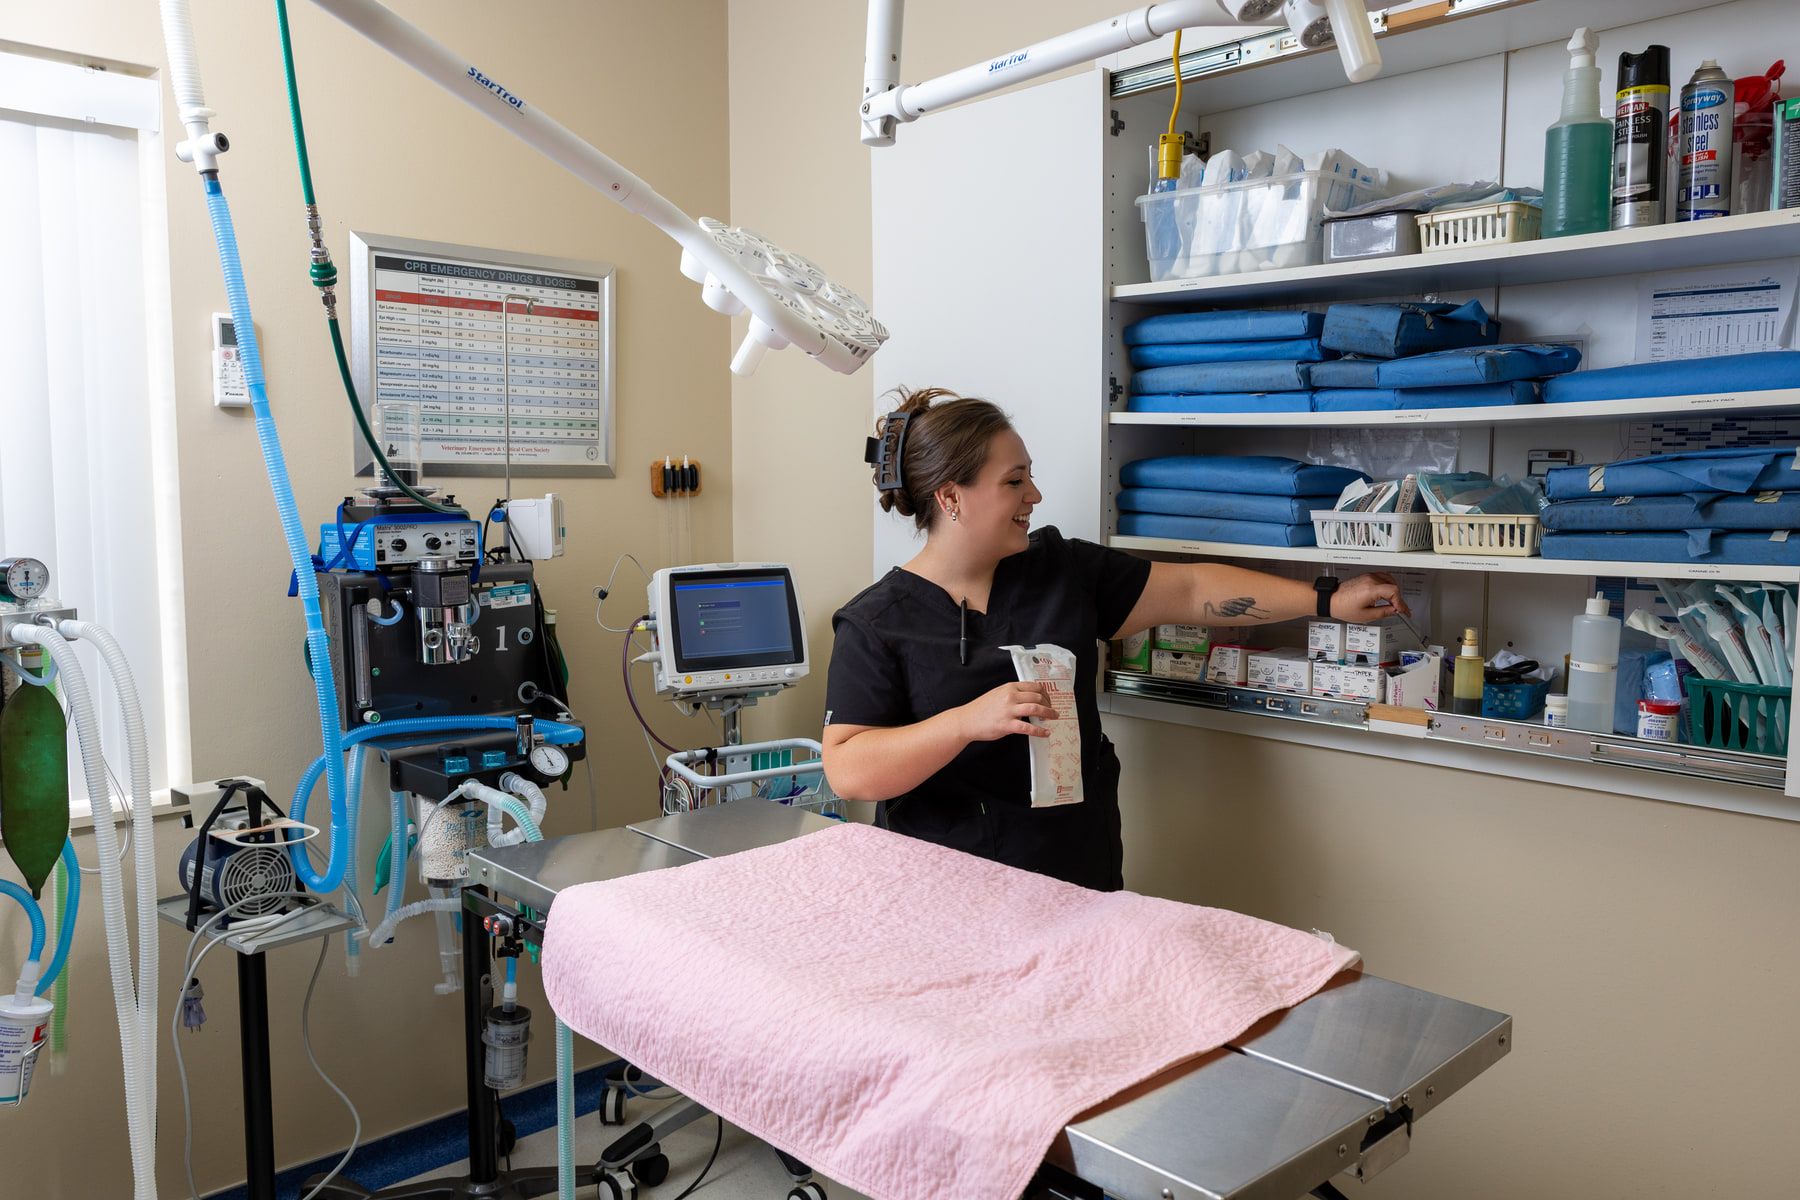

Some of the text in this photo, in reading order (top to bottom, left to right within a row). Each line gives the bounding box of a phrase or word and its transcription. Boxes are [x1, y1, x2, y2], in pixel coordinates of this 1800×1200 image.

[989, 50, 1029, 72] StarTrol
[467, 67, 523, 108] StarTrol
[1616, 103, 1646, 116] WEIAN
[1683, 94, 1721, 107] Sprayway
[1616, 116, 1651, 128] TAINLESS
[1618, 126, 1640, 136] STEEL
[1682, 112, 1719, 135] stainless
[1688, 132, 1708, 153] steel
[404, 261, 428, 272] CPR
[430, 264, 498, 280] EMERGENCY
[498, 272, 533, 283] DRUGS
[545, 278, 577, 288] DOSES
[496, 625, 508, 652] 1
